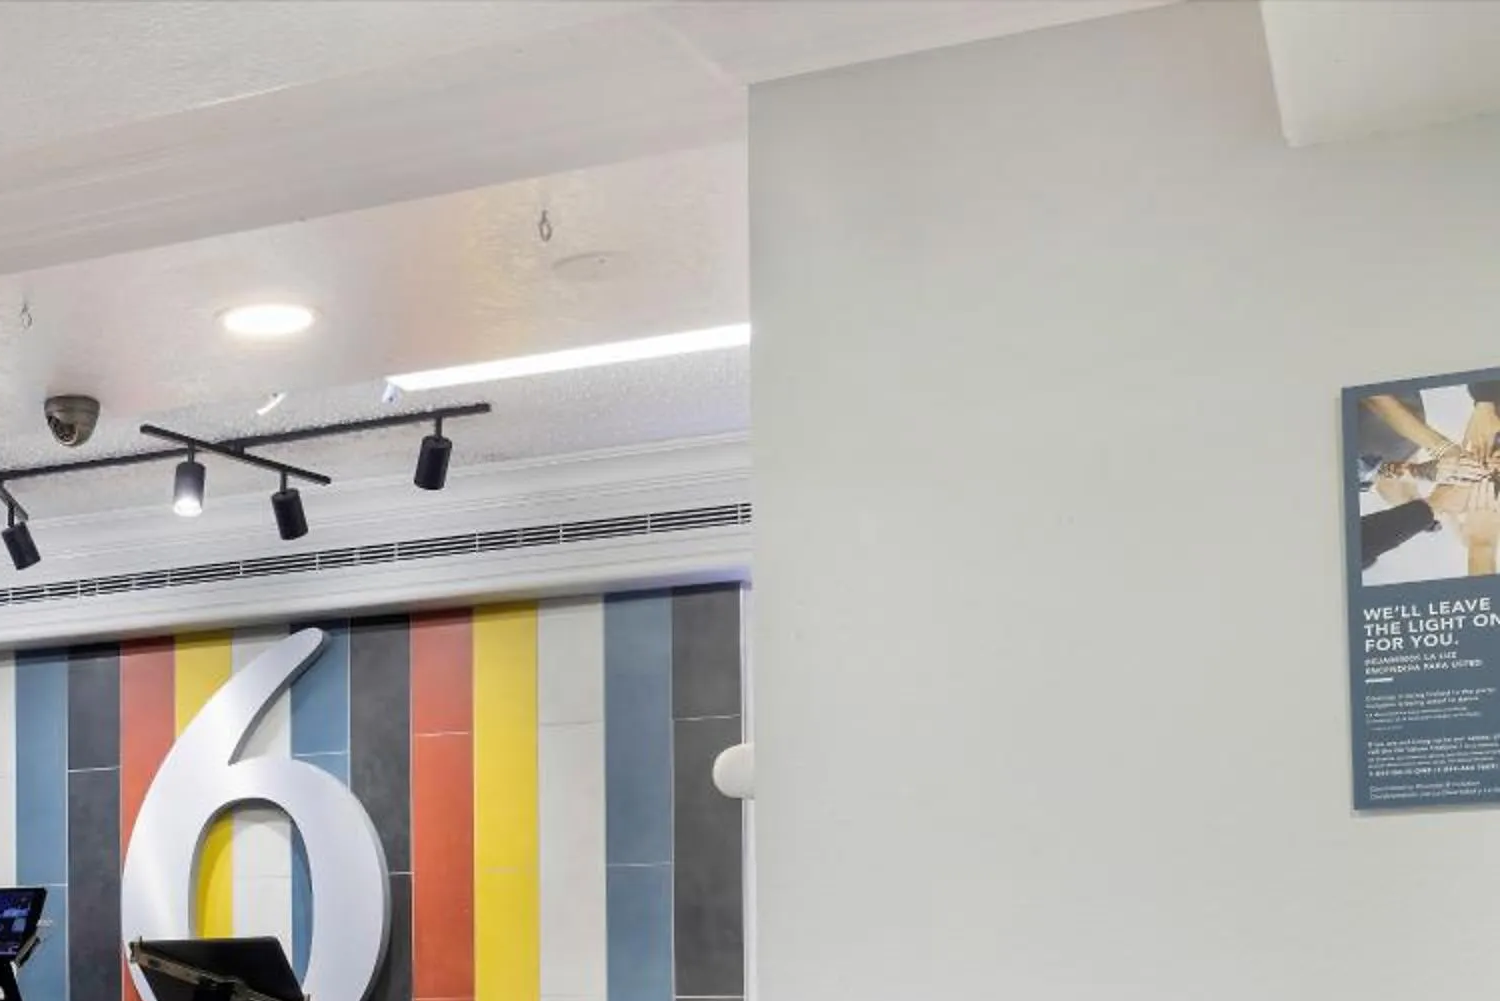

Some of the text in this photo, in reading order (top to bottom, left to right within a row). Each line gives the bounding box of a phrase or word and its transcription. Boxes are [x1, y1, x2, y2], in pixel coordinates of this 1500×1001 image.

[1363, 597, 1491, 621] WE'LL LEAVE
[1363, 621, 1402, 637] THE
[1408, 615, 1467, 633] LIGHT
[1364, 632, 1459, 653] FOR YOU.
